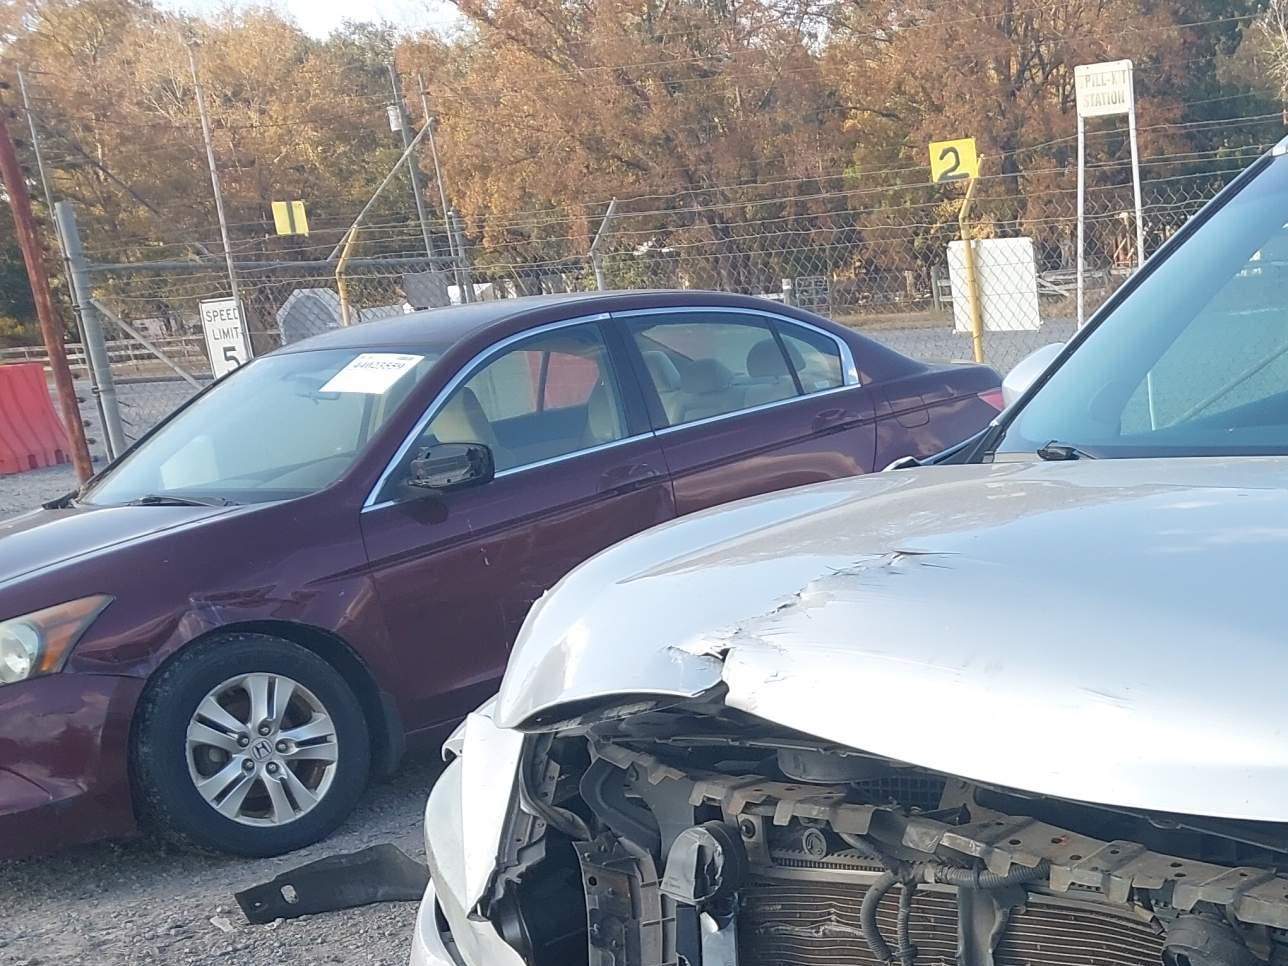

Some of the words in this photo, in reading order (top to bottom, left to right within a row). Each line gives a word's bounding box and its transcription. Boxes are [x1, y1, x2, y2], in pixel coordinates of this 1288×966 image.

[938, 146, 970, 182] 2
[212, 326, 239, 341] LIMIT
[222, 345, 241, 372] 5
